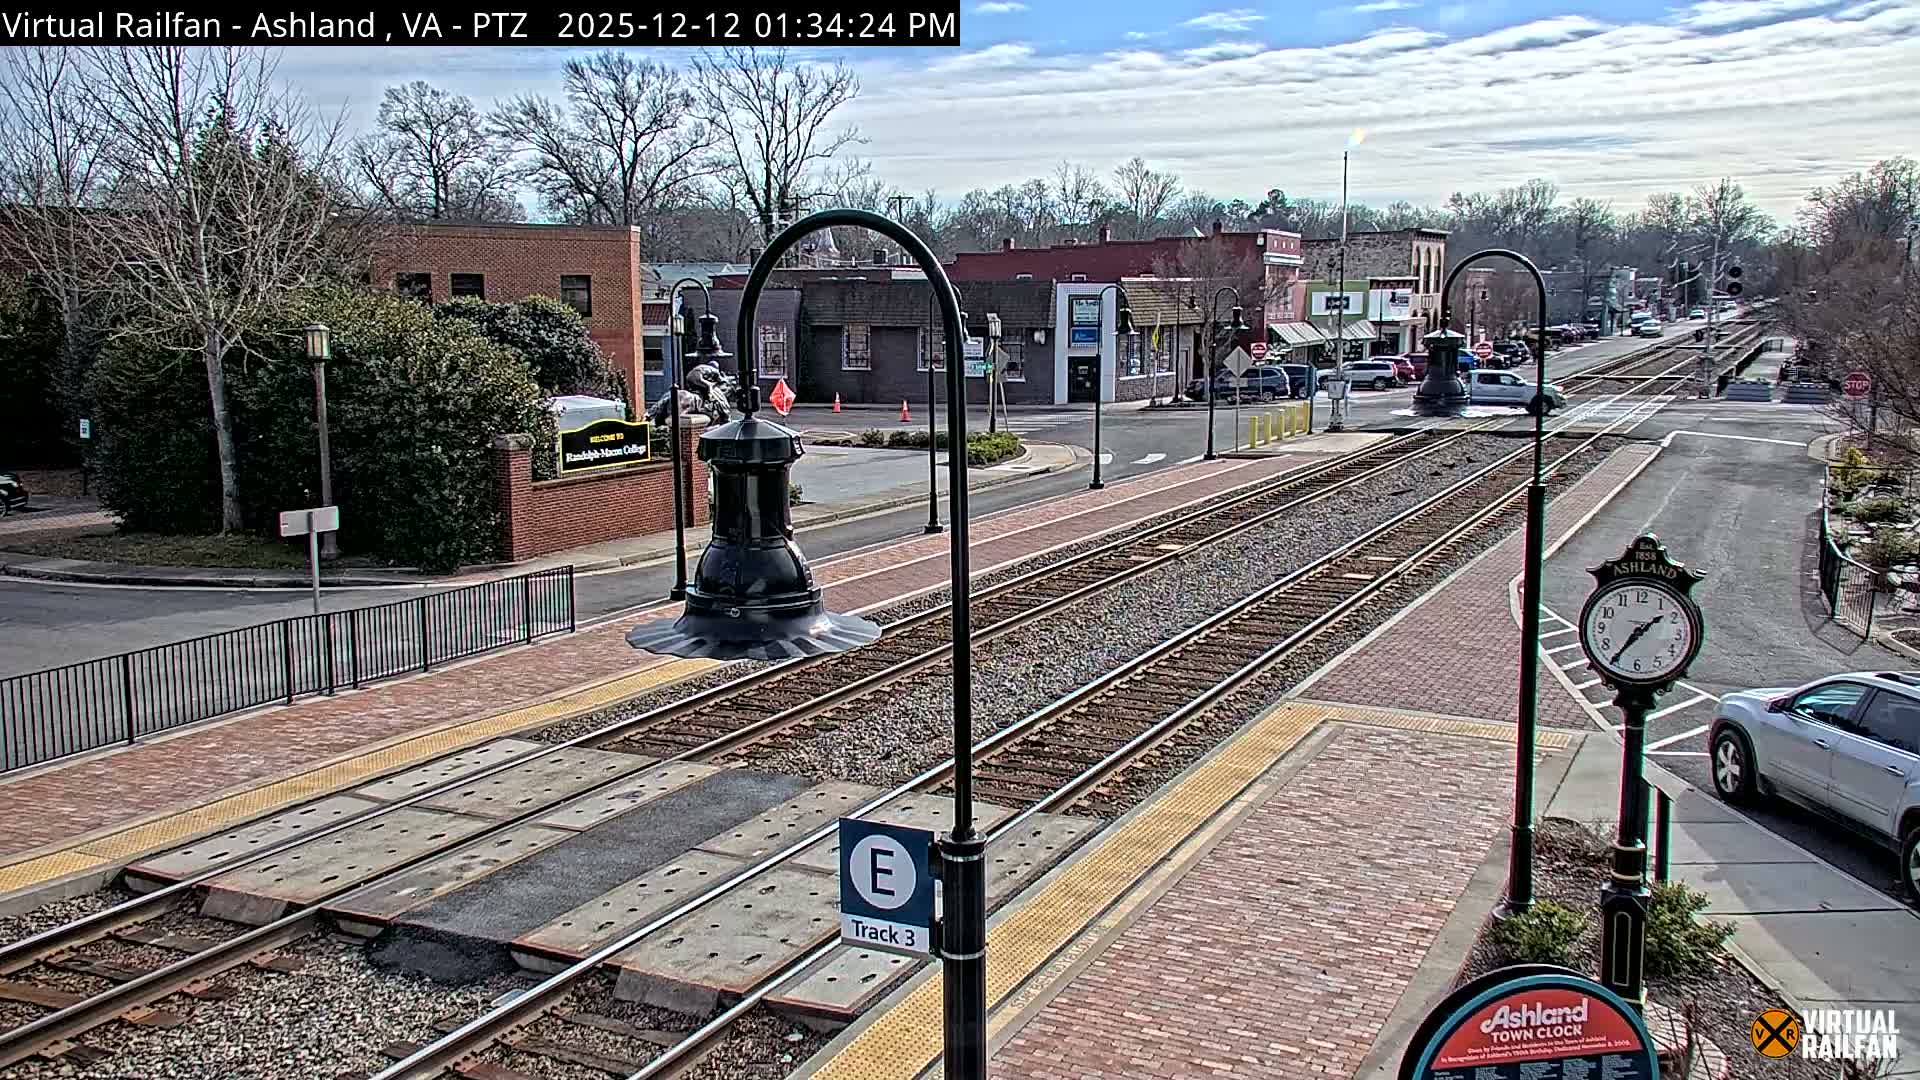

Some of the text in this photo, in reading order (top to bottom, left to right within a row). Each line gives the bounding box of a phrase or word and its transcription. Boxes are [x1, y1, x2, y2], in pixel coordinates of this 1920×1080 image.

[1844, 380, 1869, 390] STOP
[1614, 561, 1677, 579] ASHLAND
[1618, 594, 1628, 607] 11
[1636, 591, 1649, 603] 12
[1658, 598, 1664, 610] 1
[1602, 607, 1614, 619] 10
[1671, 612, 1678, 625] 2
[1598, 622, 1606, 634] 9
[1675, 629, 1682, 641] 3
[1601, 638, 1611, 650] 8
[1668, 644, 1676, 657] 4
[1633, 659, 1641, 671] 6
[1653, 656, 1663, 668] 5
[870, 847, 896, 896] E
[851, 919, 915, 947] Track 3
[1480, 997, 1589, 1034] Ashland
[1490, 1024, 1583, 1044] TOWN CLOCK
